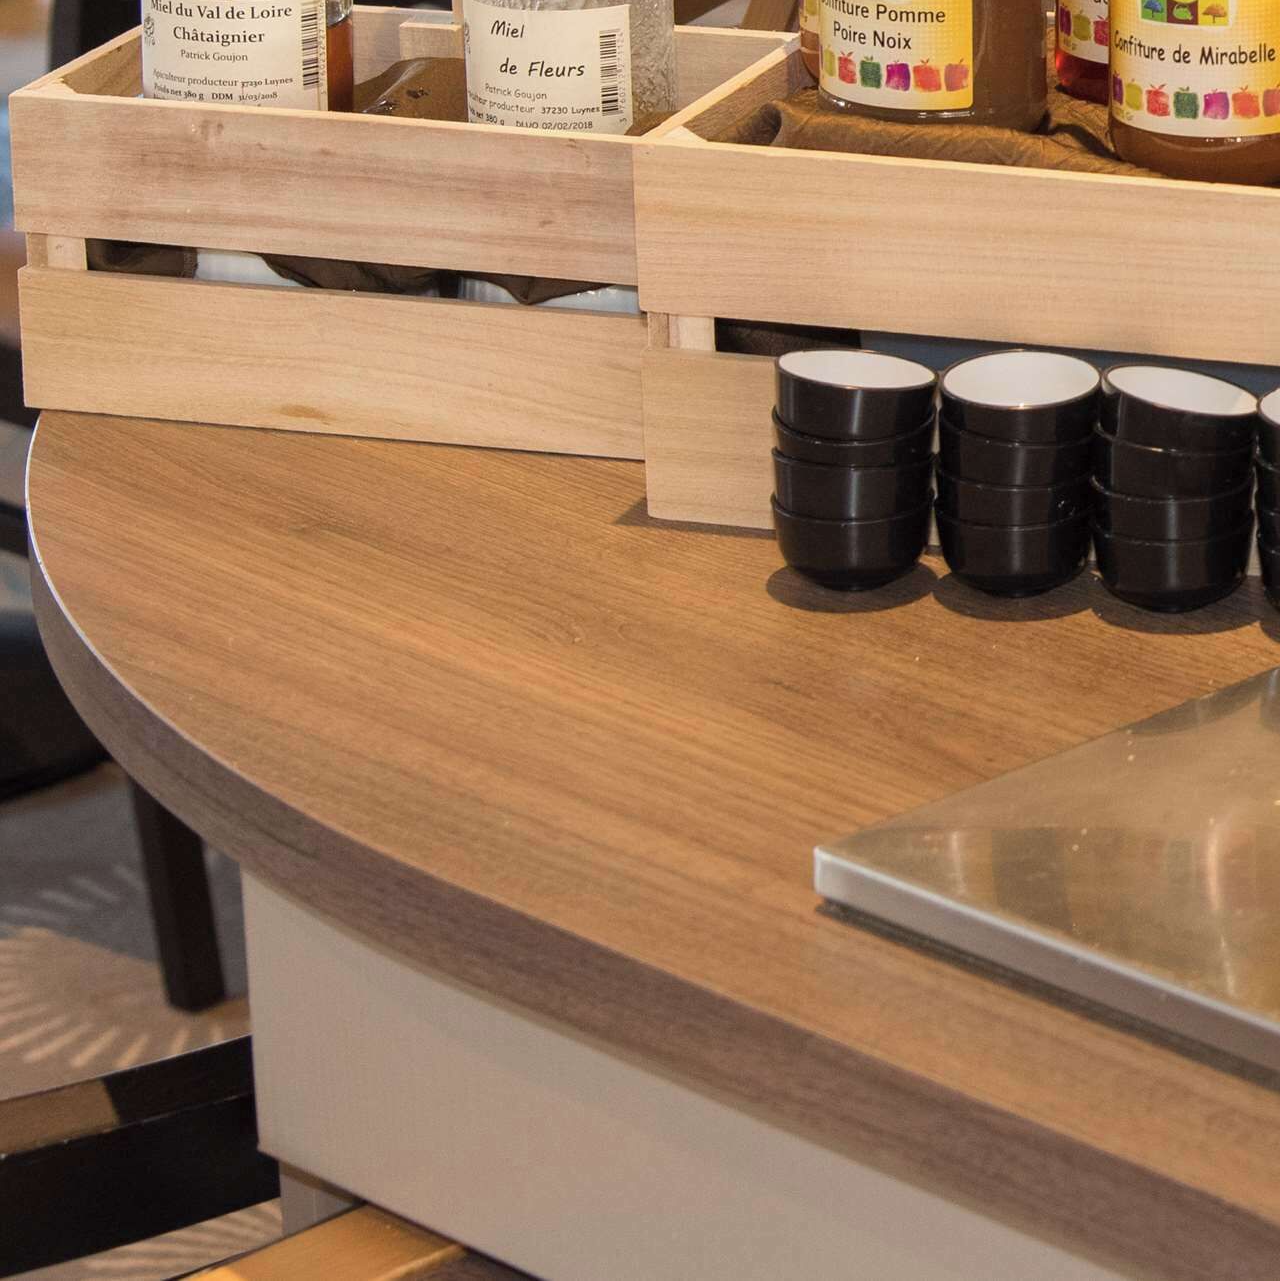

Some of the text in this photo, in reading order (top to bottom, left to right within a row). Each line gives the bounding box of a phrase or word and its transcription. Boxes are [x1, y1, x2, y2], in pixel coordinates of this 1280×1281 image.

[176, 3, 193, 18] du
[197, 6, 221, 20] Val
[225, 6, 246, 20] de
[251, 5, 293, 20] Loire
[876, 3, 947, 24] Pomme
[173, 25, 265, 47] Châtaignier
[490, 20, 525, 39] Miel
[833, 21, 912, 50] Poire Noix
[180, 49, 249, 64] Patrick Goujon
[1114, 29, 1276, 66] Confiture de Mirabelle
[499, 57, 585, 78] de Fleurs
[188, 75, 238, 89] producteur
[264, 76, 294, 87] Luynes
[170, 89, 183, 98] net
[211, 92, 233, 101] DDM
[484, 82, 548, 102] Patrick Goujon
[489, 99, 536, 114] producteur
[541, 106, 568, 115] 37230
[571, 106, 600, 117] Luynes
[542, 120, 593, 130] 02/02/2018
